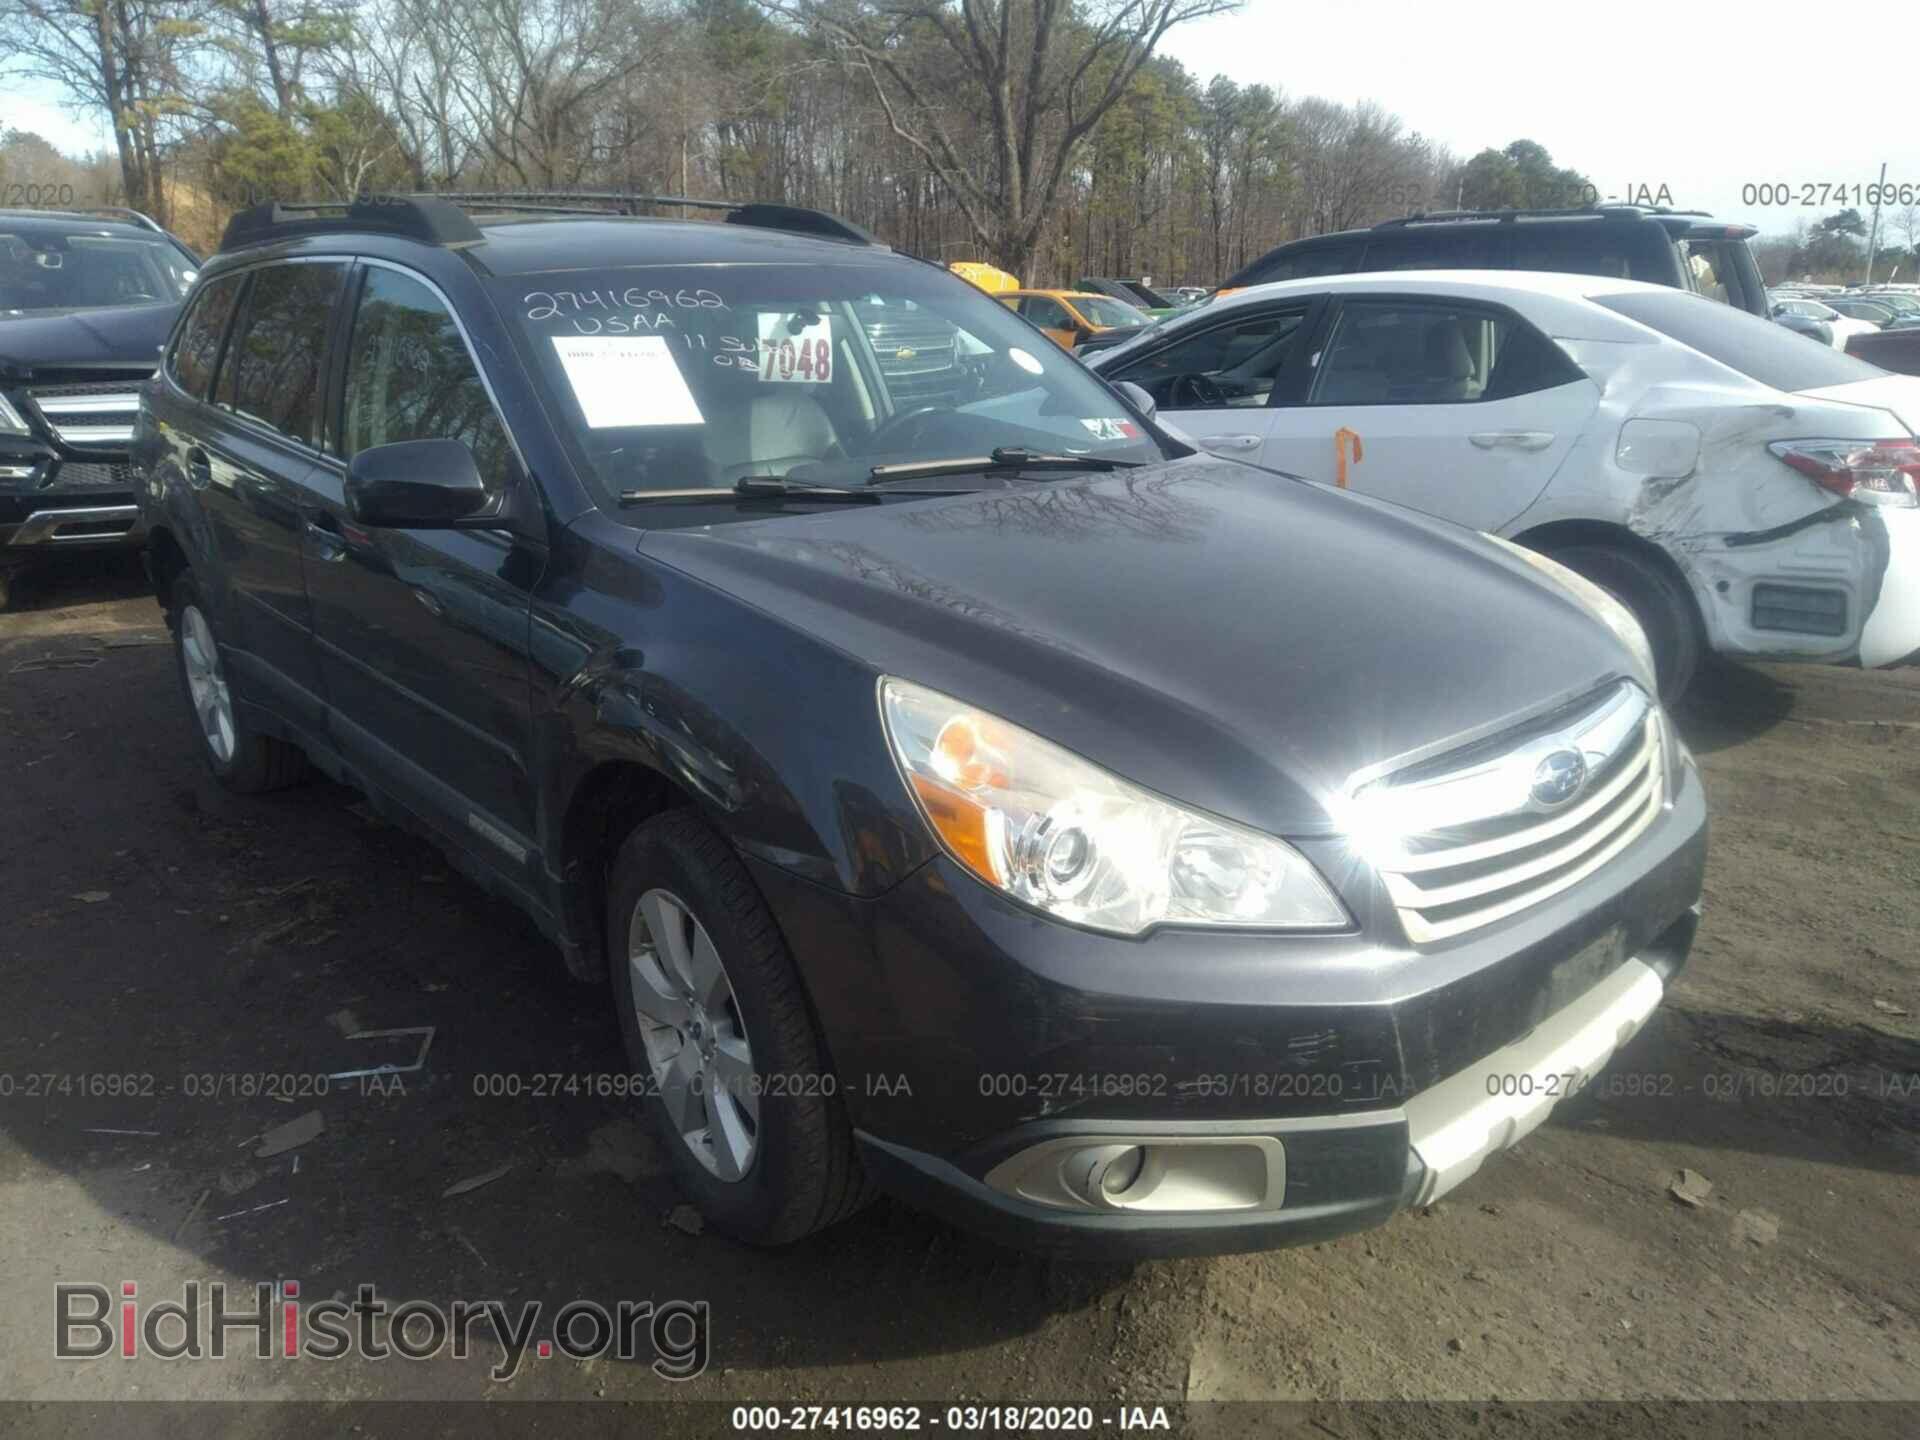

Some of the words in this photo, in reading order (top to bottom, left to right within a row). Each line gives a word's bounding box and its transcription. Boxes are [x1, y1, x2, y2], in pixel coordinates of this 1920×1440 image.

[525, 288, 731, 320] 27416962
[572, 311, 676, 335] USAA
[761, 337, 831, 381] 7048
